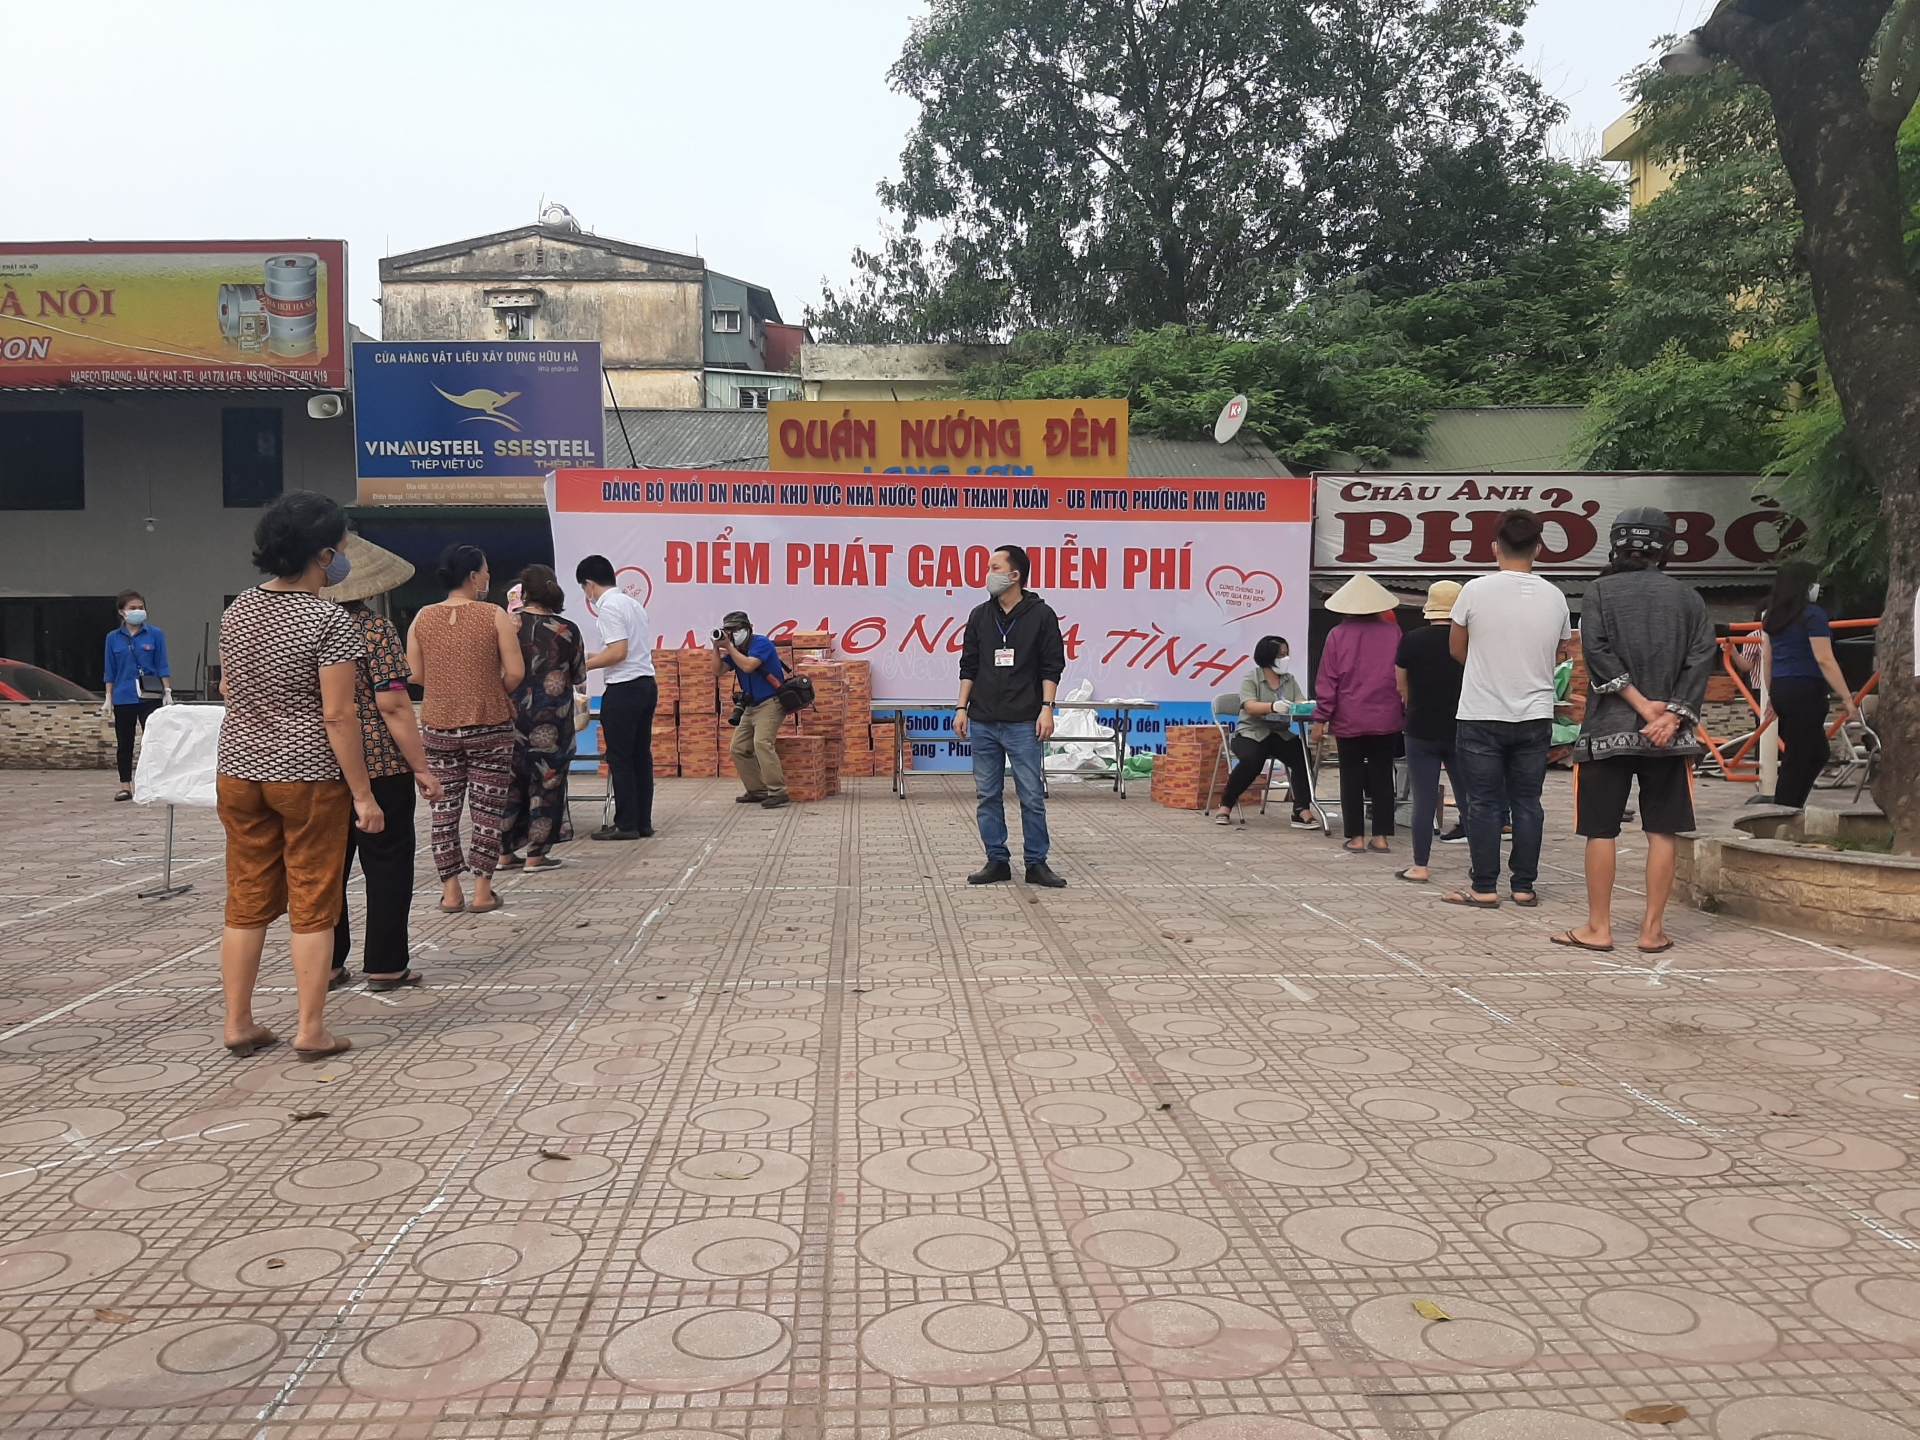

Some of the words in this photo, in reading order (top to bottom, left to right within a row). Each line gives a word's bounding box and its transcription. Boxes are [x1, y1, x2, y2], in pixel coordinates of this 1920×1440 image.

[36, 283, 116, 323] NỘI
[0, 337, 51, 359] ON
[375, 350, 397, 364] CỬA
[399, 350, 429, 364] HÀNG
[431, 350, 453, 366] VẬT
[455, 350, 479, 365] LIỆU
[482, 350, 503, 363] XÂY
[506, 350, 536, 365] DỰNG
[538, 350, 561, 363] HỮU
[563, 349, 579, 363] HÀ
[101, 370, 132, 383] TRADING
[163, 370, 178, 383] HAT
[365, 440, 484, 456] VINAUSTEEL
[493, 440, 595, 457] SSESTEEL
[779, 408, 877, 461] QUÁN
[901, 408, 1022, 459] NƯỚNG
[1042, 407, 1117, 457] ĐÊM
[410, 458, 440, 470] THÉP
[441, 458, 466, 471] VIỆT
[467, 458, 485, 469] ÚC
[602, 476, 641, 502] ĐẢNG
[645, 478, 665, 507] BỘ
[669, 476, 704, 504] KHỐI
[708, 483, 728, 504] DN
[732, 480, 775, 505] NGOÀI
[780, 484, 809, 505] KHU
[812, 482, 843, 509] VỰC
[846, 483, 875, 506] NHÀ
[878, 482, 917, 507] NƯỚC
[921, 484, 958, 511] QUẬN
[963, 487, 1008, 508] THANH
[1012, 485, 1049, 509] XUÂN
[1066, 489, 1086, 509] UB
[1090, 489, 1129, 512] MTTQ
[1132, 486, 1189, 511] PHƯỜNG
[1193, 490, 1219, 511] KIM
[1224, 491, 1266, 511] GIANG
[1334, 487, 1600, 563] PHỞ
[1664, 494, 1809, 563] BÒ
[664, 526, 770, 585] ĐIỂM
[786, 537, 894, 587] PHÁT
[908, 543, 990, 596] GẠO
[1122, 541, 1194, 590] PHÍ
[1100, 621, 1250, 687] TÌNH
[1136, 714, 1160, 733] đến
